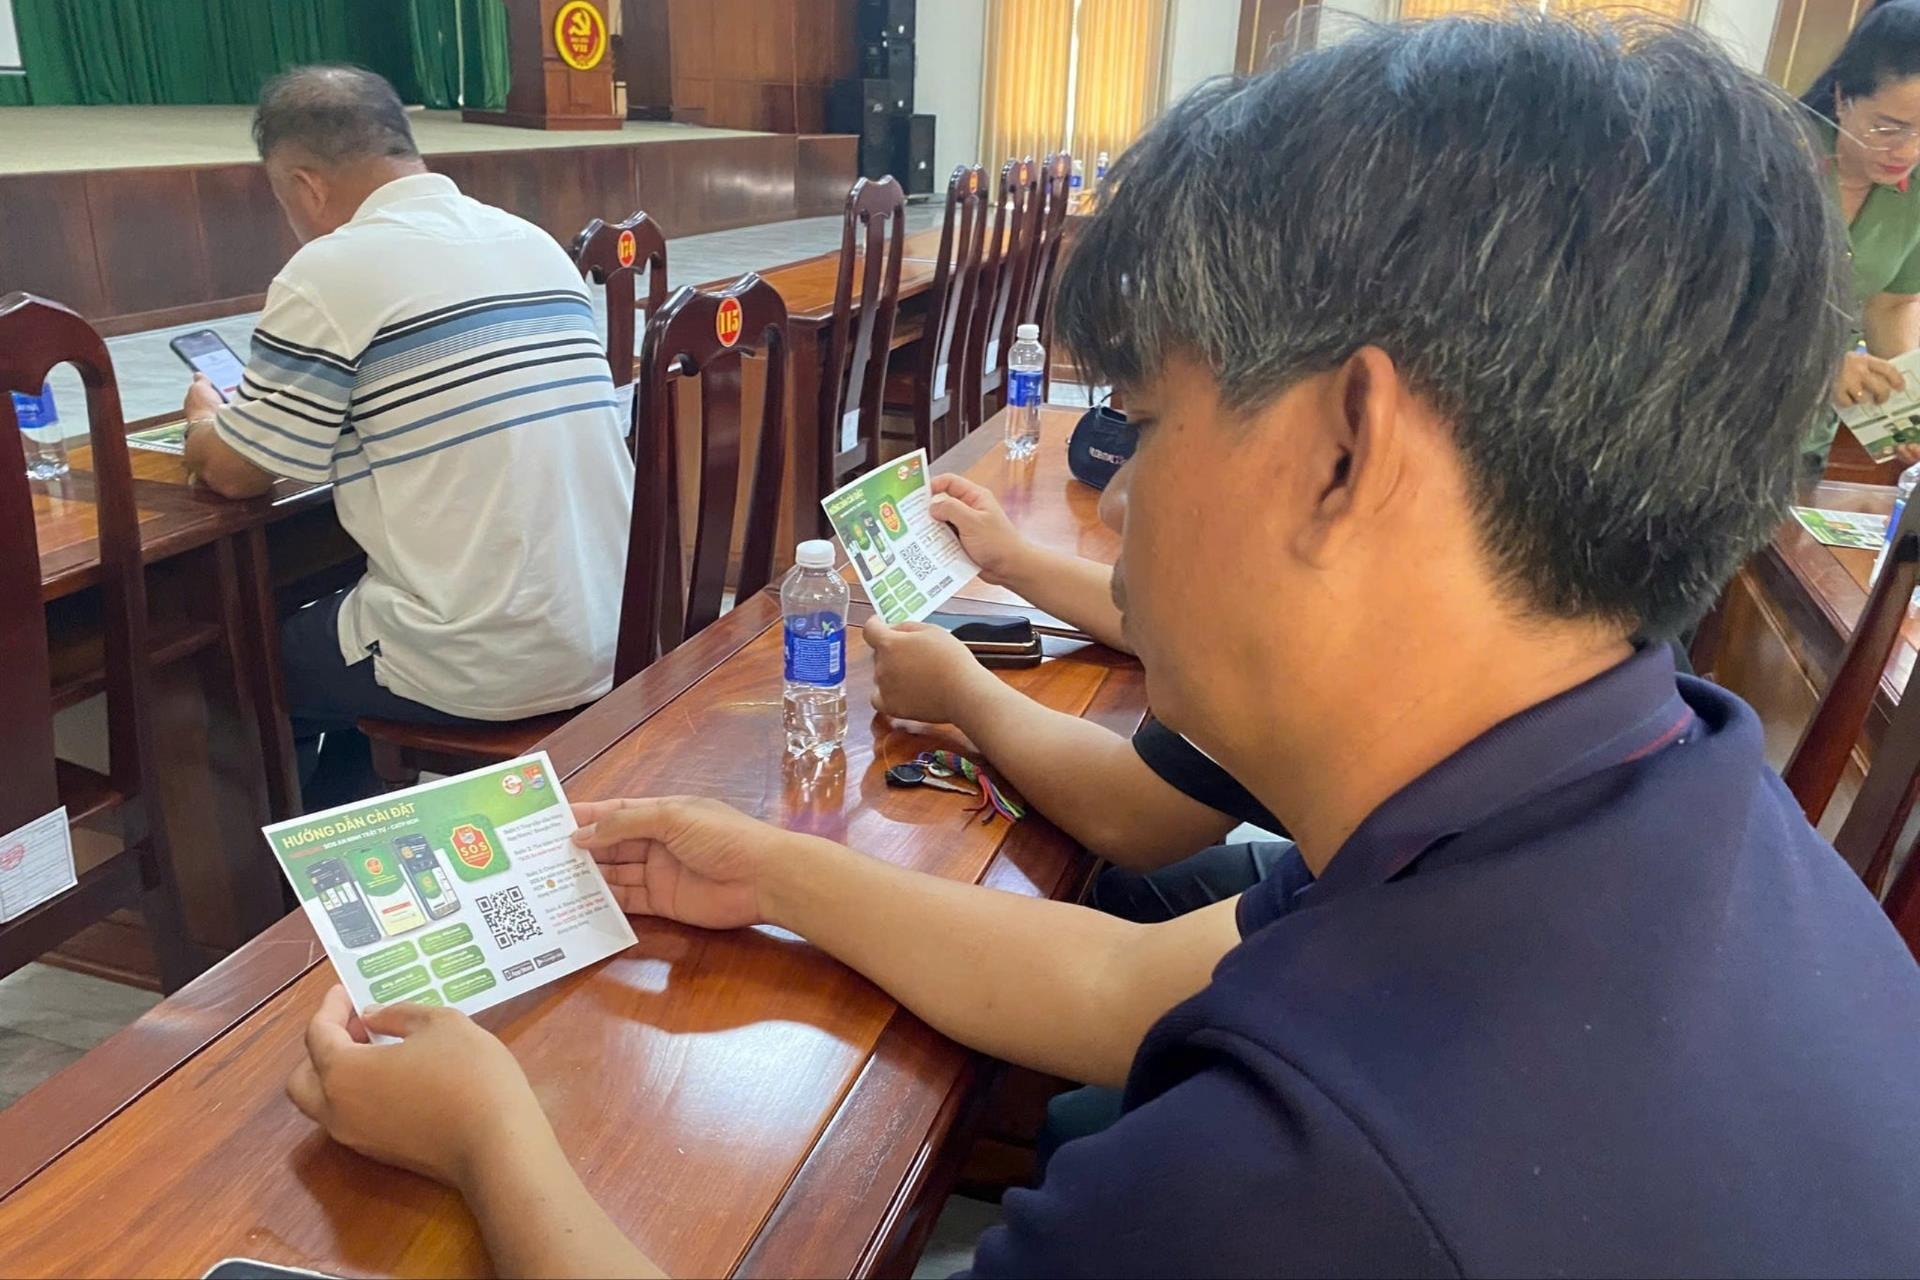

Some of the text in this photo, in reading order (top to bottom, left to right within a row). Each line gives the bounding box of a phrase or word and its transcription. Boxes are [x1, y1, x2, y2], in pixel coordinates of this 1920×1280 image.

[719, 310, 739, 335] 115
[282, 802, 416, 849] HƯỚNG DẪN CÀI ĐẶT
[460, 841, 488, 857] SOS
